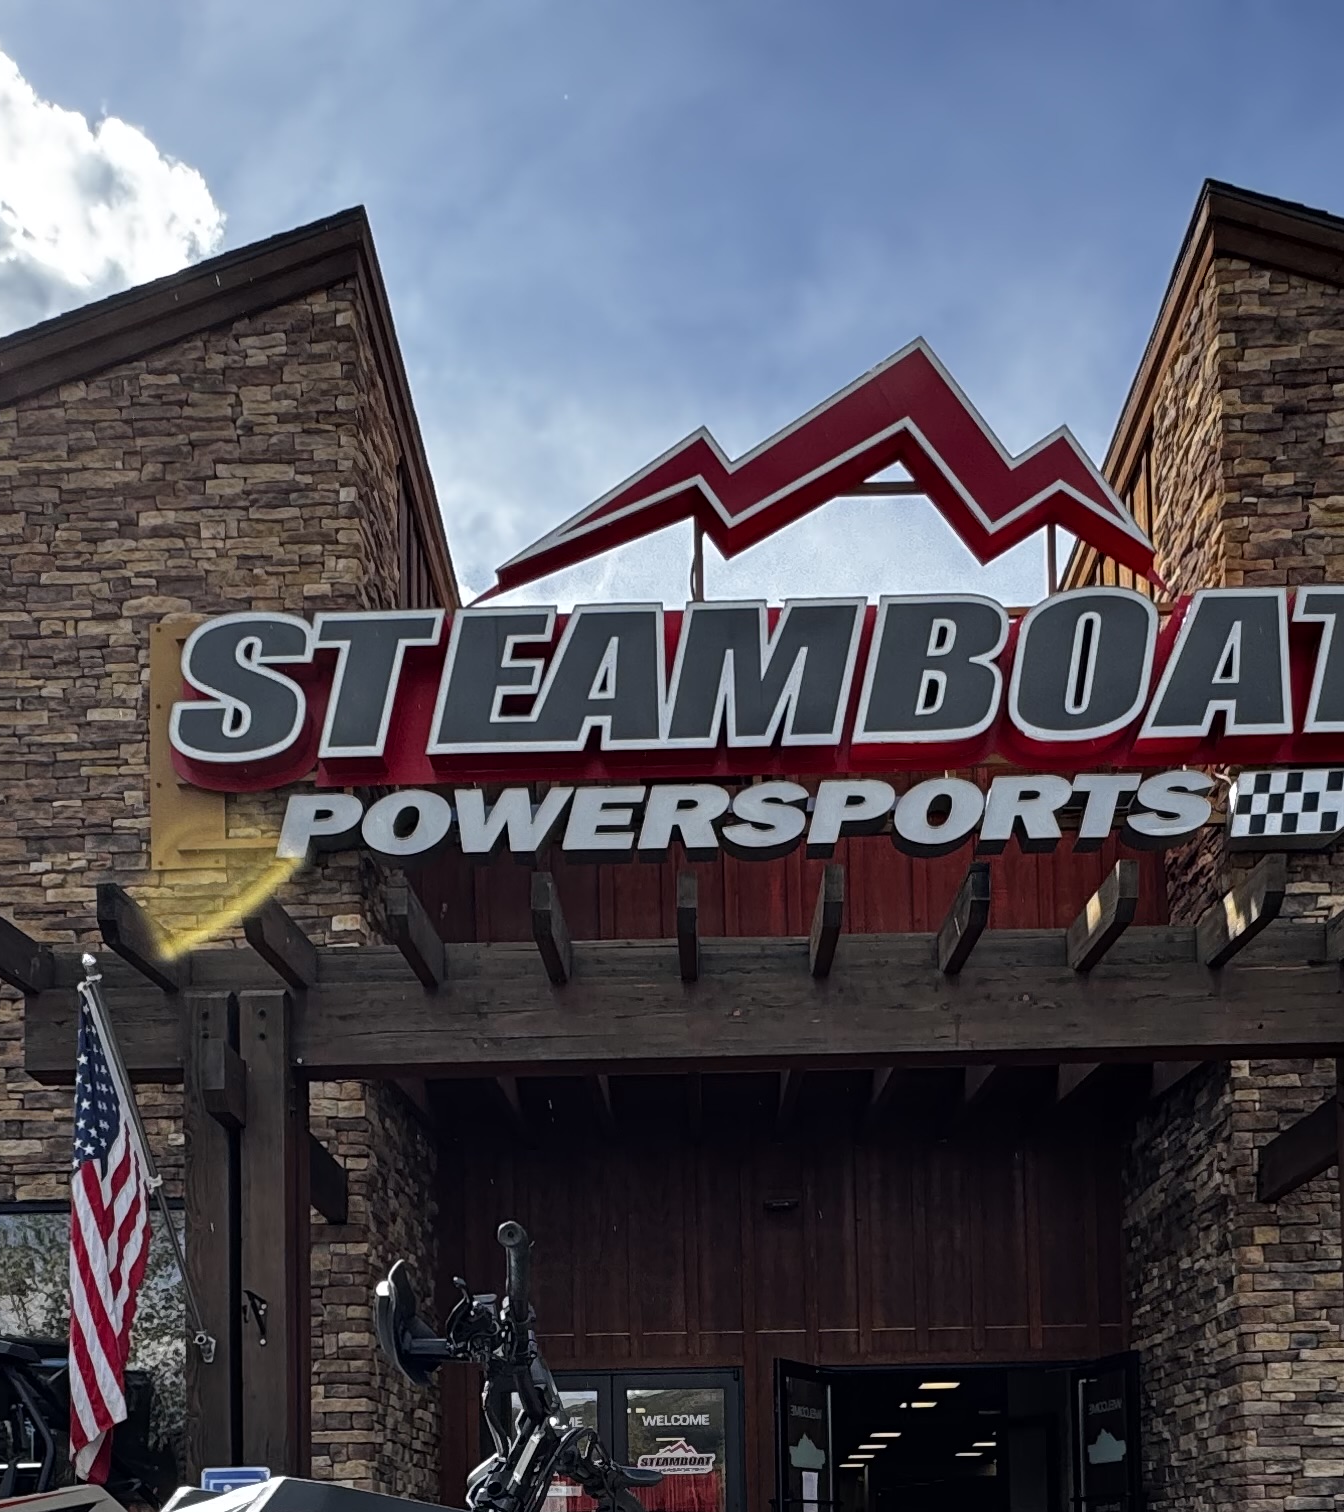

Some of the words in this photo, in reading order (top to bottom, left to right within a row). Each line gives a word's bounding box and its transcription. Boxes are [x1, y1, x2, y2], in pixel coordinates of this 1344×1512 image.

[276, 770, 1212, 858] POWERSPORTS
[642, 1414, 710, 1426] WELCOME
[640, 1455, 713, 1467] STEAMBOAT
